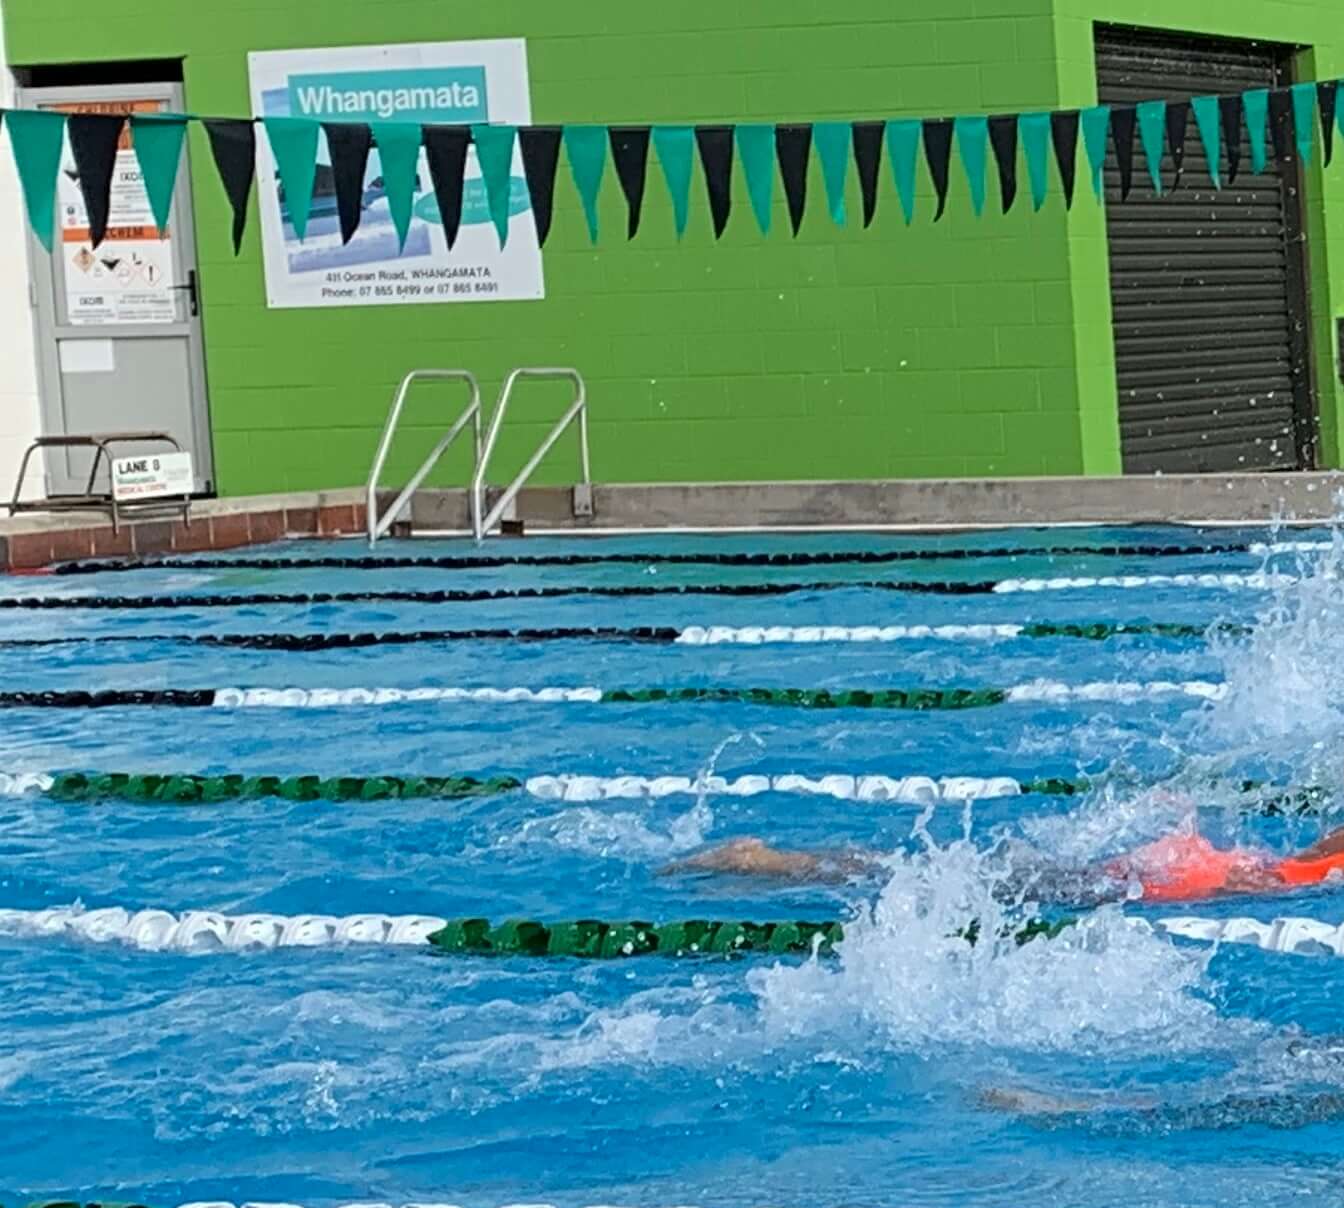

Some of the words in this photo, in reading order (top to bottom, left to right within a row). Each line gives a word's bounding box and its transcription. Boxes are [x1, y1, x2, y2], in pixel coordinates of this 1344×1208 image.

[297, 81, 479, 118] Whangamata
[343, 271, 376, 282] Ocean
[378, 269, 408, 281] Road,
[412, 267, 491, 279] WHANGAMATA
[423, 285, 434, 294] or
[118, 459, 148, 475] LANE
